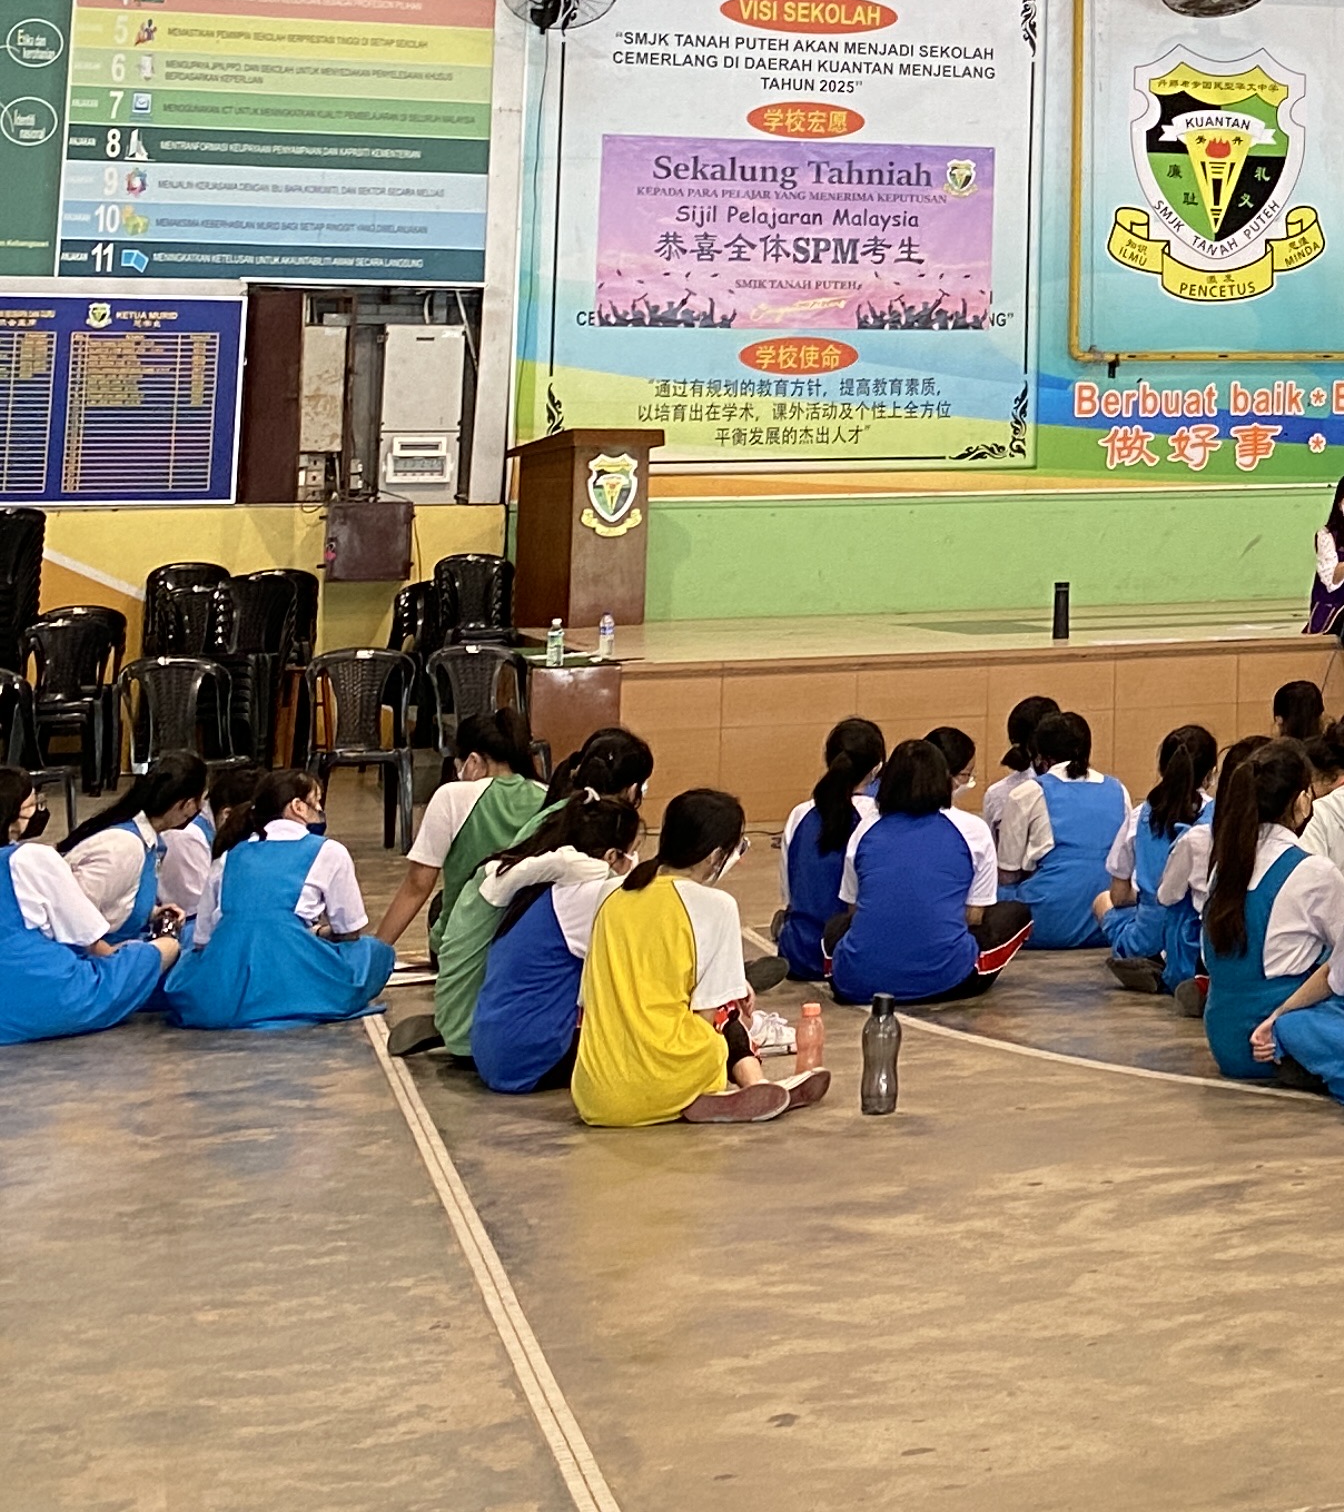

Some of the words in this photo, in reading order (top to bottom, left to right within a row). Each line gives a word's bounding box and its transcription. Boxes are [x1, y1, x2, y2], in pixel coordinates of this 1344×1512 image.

[738, 0, 777, 23] VISI
[784, 2, 882, 28] SEKOLAH
[674, 33, 729, 48] TANAH
[735, 36, 788, 51] PUTEH
[793, 39, 838, 53] AKAN
[844, 41, 913, 56] MENJADI
[919, 45, 993, 60] SEKOLAH
[612, 51, 717, 68] CEMERLANG
[723, 55, 739, 68] DI
[744, 57, 811, 71] DAERAH
[818, 59, 893, 74] KUANTAN
[899, 63, 995, 79] MENJELANG
[760, 77, 814, 91] TAHUN
[109, 90, 124, 119] 7
[763, 107, 848, 134] 学校宏愿
[1185, 117, 1251, 131] KUANTAN
[105, 129, 121, 158] 8
[652, 155, 798, 190] Sekalung
[807, 159, 931, 186] Tahniah
[95, 205, 120, 233] 10
[675, 205, 716, 228] Sijil
[727, 205, 822, 229] Pelajaran
[832, 208, 918, 232] Malaysia
[1153, 200, 1185, 233] SMJK
[1192, 235, 1239, 256] TANAH
[1244, 201, 1280, 239] PUTEH
[91, 243, 115, 272] 11
[654, 231, 925, 265] 恭喜全体SPM考生
[1118, 247, 1148, 267] ILMU
[1284, 242, 1321, 268] MINDA
[1179, 282, 1256, 298] PENCETUS
[755, 344, 842, 370] 学校使命
[1074, 382, 1216, 416] Berbuat
[1231, 382, 1302, 414] baik
